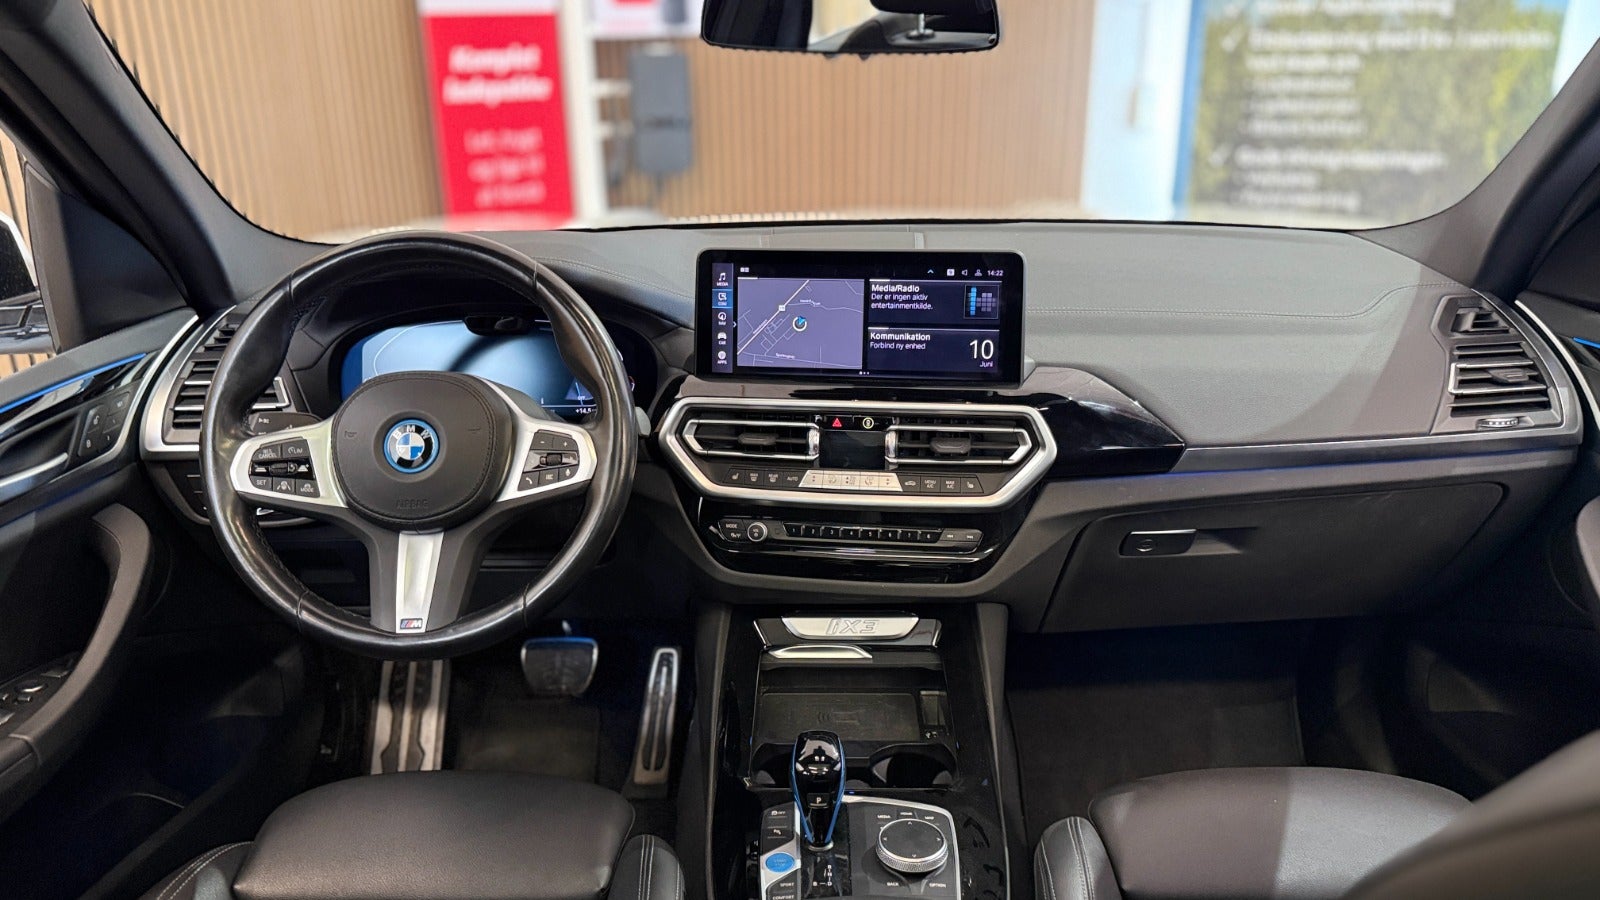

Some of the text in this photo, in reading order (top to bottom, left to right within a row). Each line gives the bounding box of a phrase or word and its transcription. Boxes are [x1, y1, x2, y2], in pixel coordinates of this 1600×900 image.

[871, 284, 920, 293] Media/Radio
[893, 293, 911, 302] ingen
[871, 302, 933, 310] entertainmentkilde.
[870, 332, 931, 341] Kommunikation
[970, 339, 994, 360] 10
[392, 424, 431, 440] BMW
